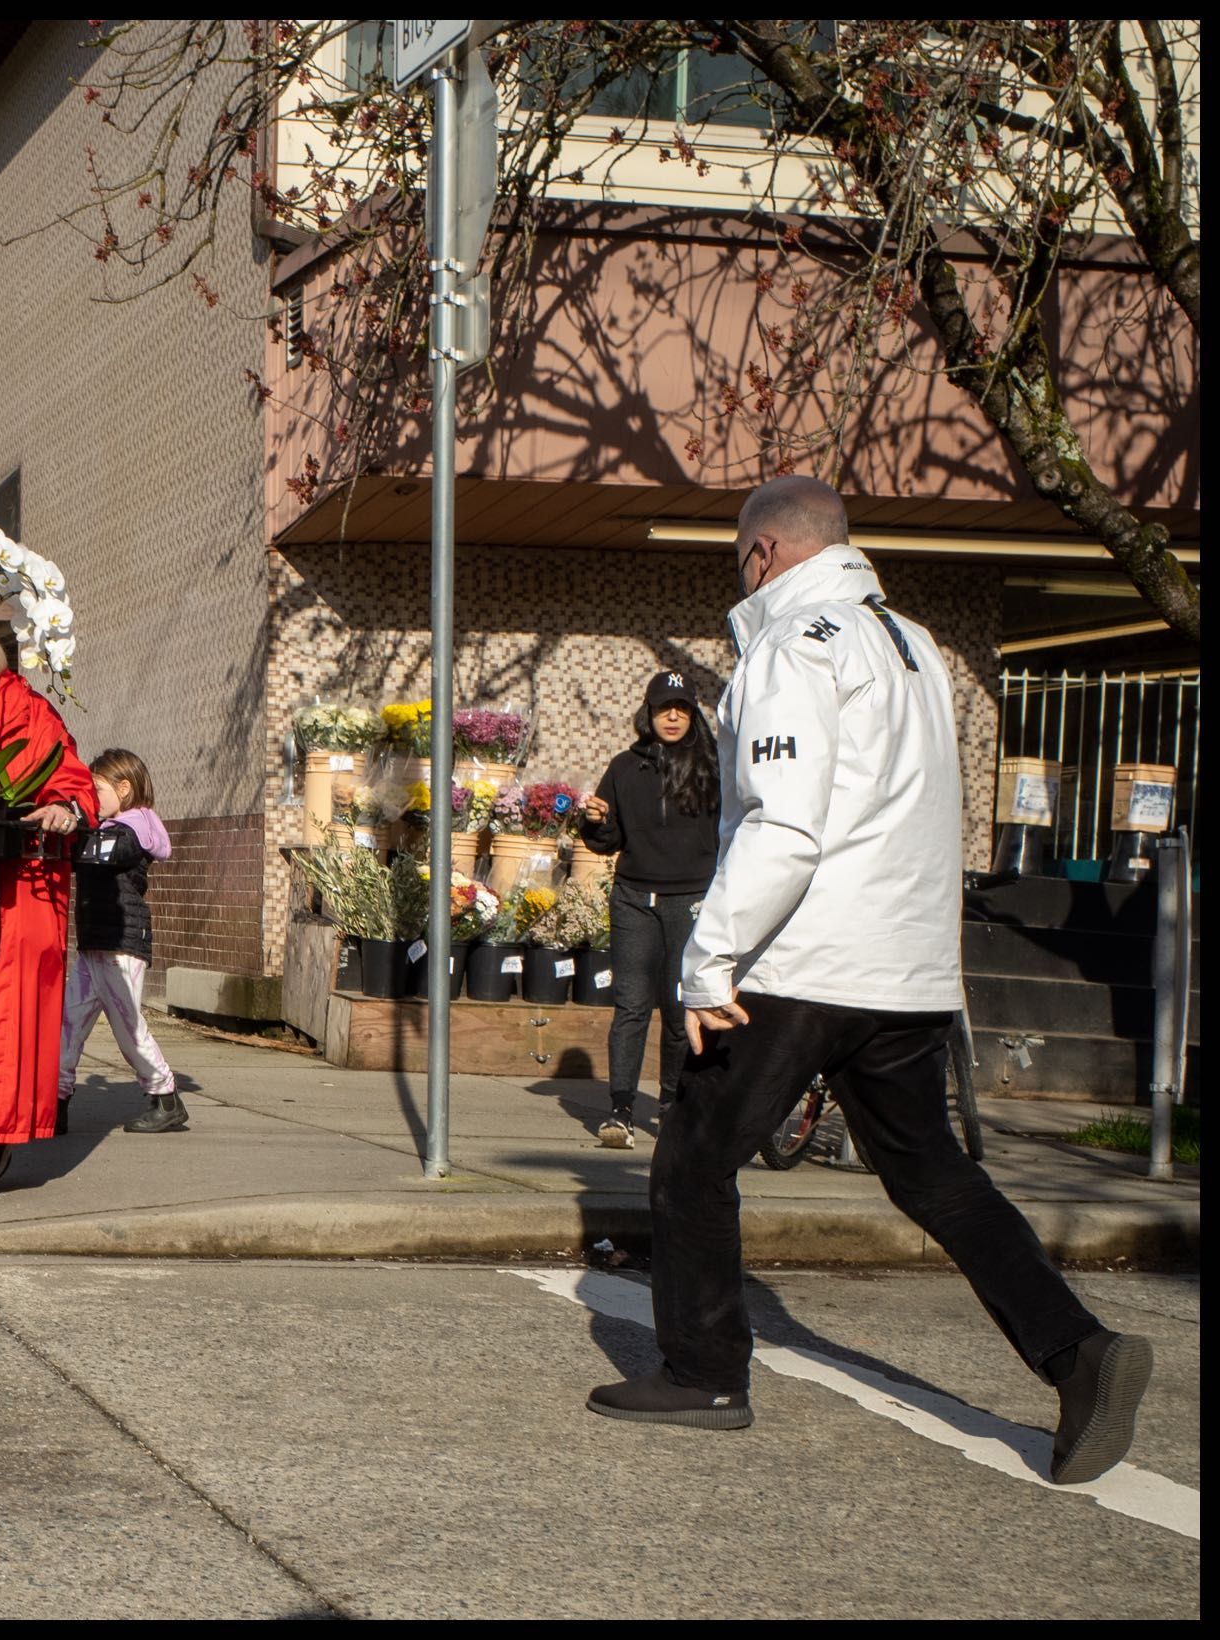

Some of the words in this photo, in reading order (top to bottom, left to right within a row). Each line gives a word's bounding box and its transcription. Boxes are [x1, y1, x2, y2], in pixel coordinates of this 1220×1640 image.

[841, 562, 861, 571] HELLY
[803, 615, 841, 643] HH
[751, 735, 797, 765] HH
